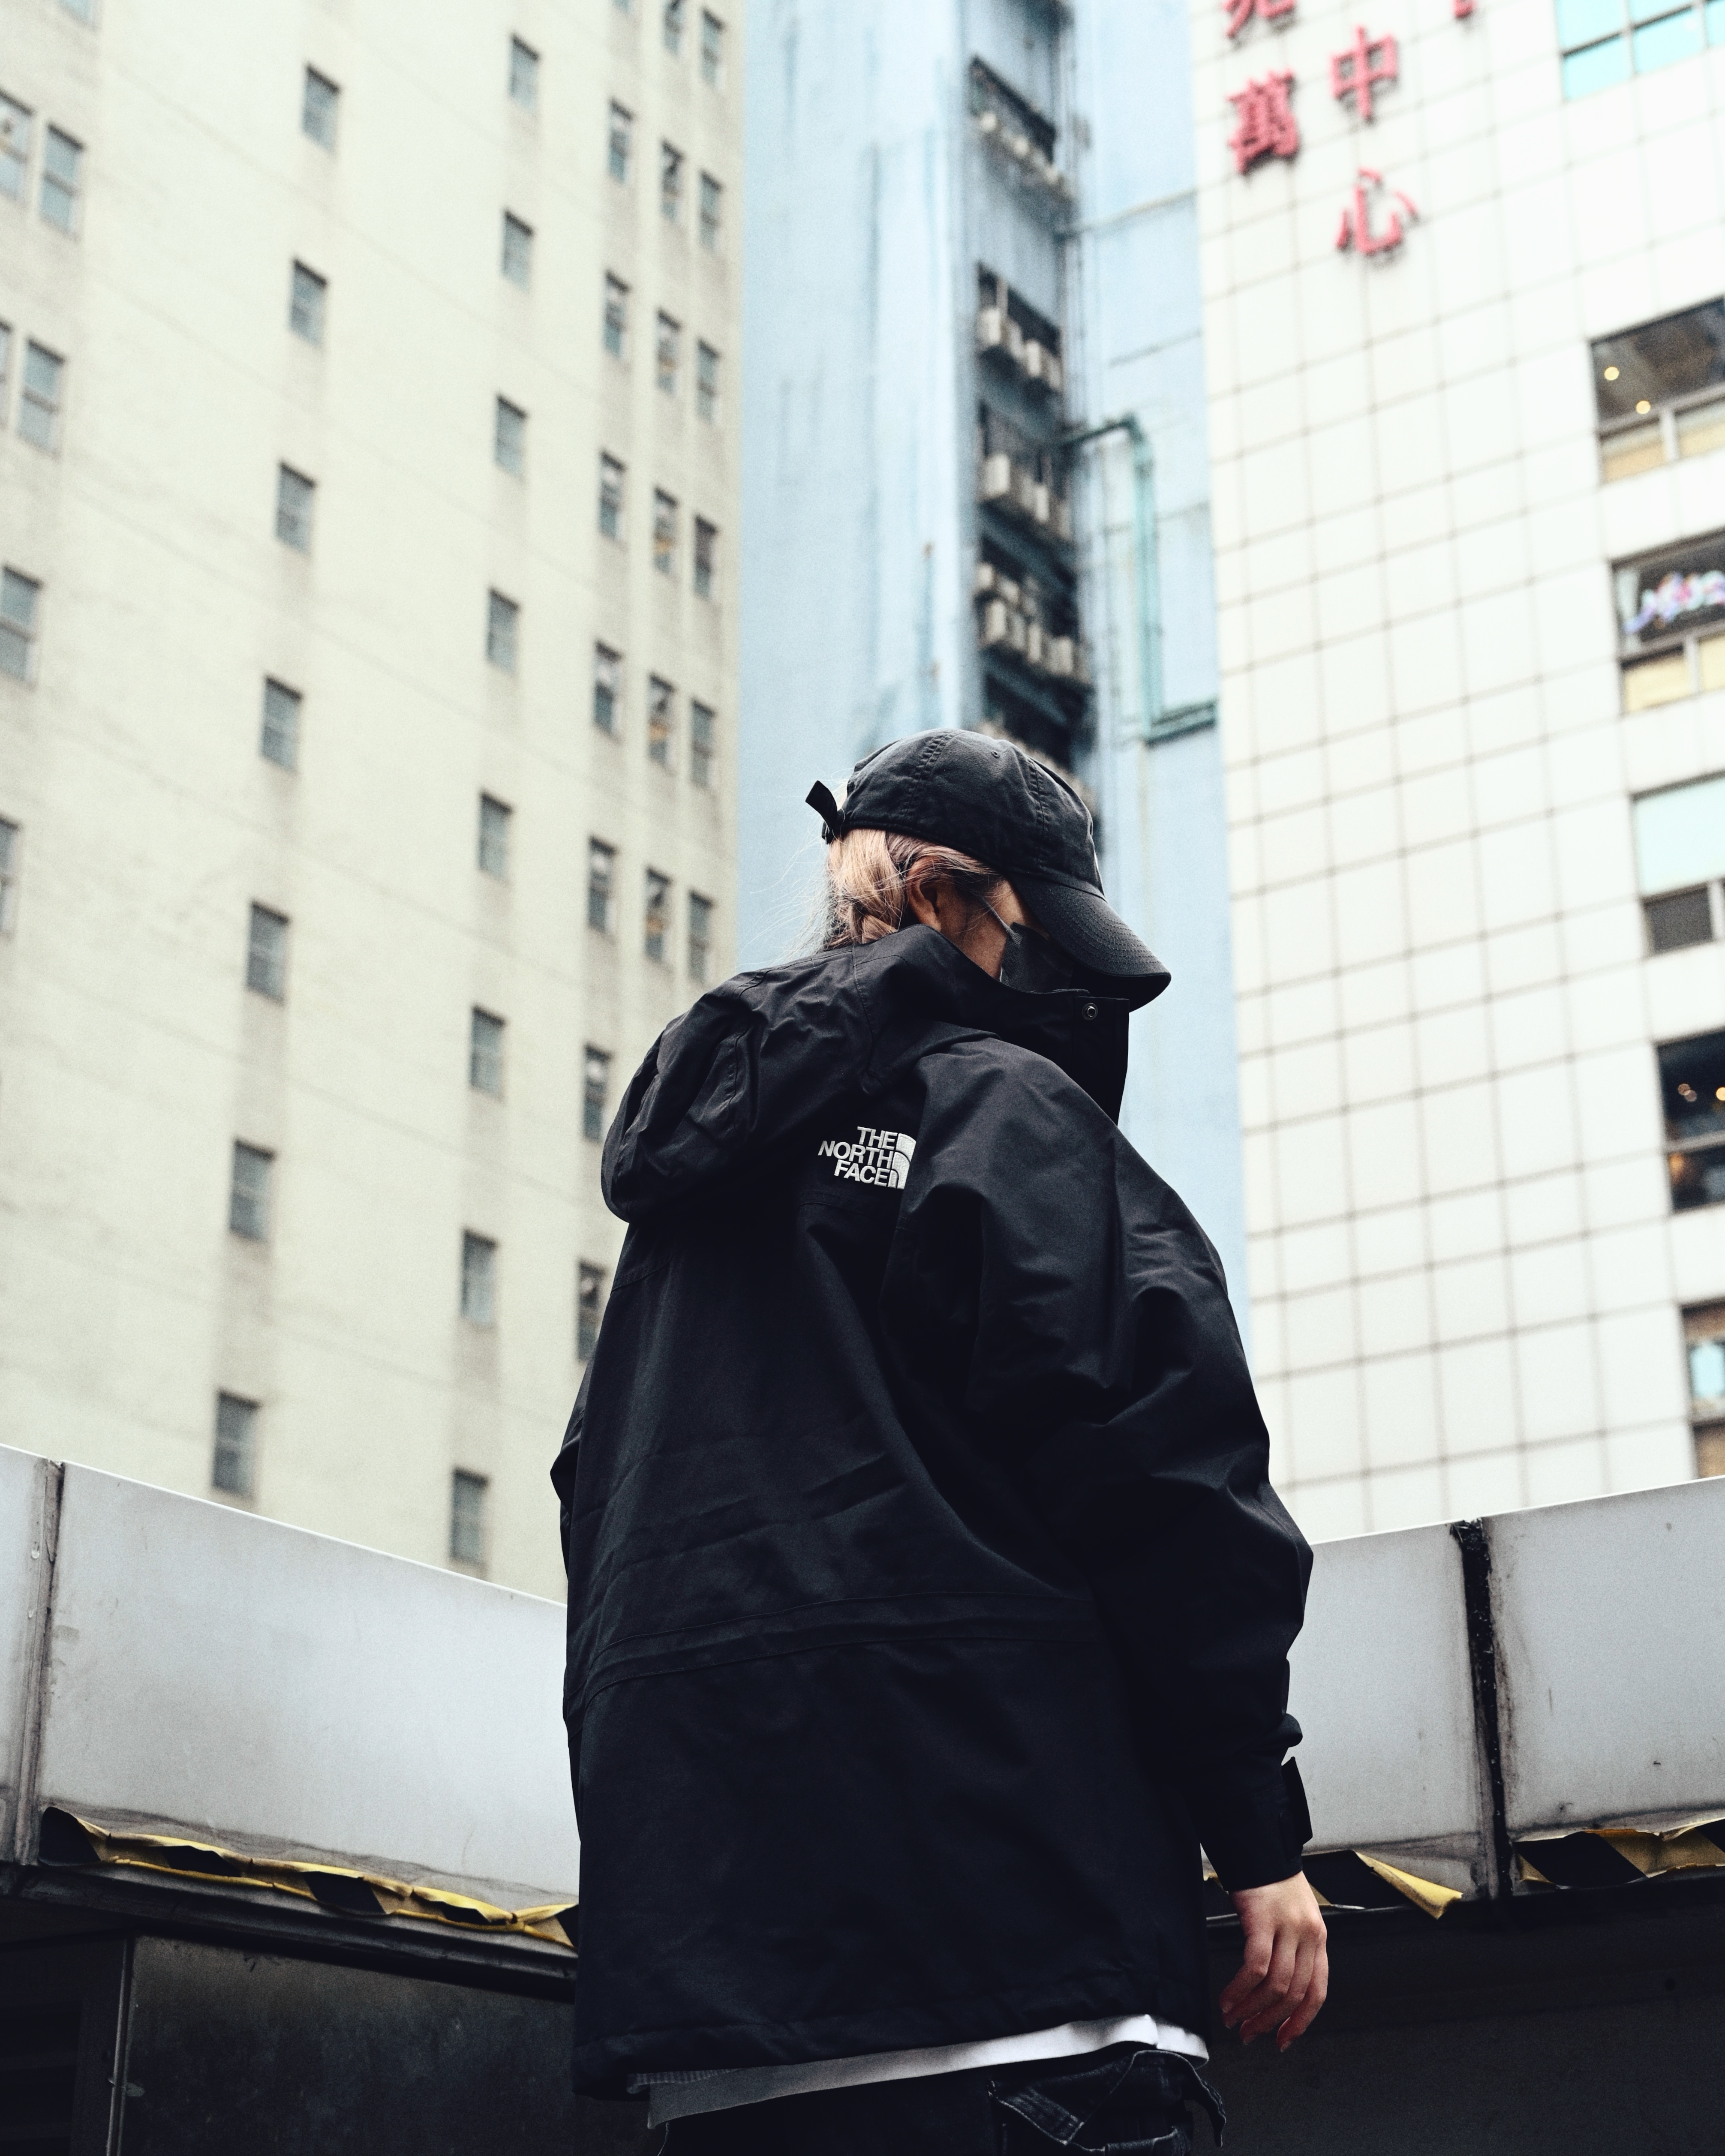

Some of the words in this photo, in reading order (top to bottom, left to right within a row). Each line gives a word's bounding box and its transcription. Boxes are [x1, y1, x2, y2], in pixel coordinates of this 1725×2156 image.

[857, 1126, 898, 1150] THE
[817, 1140, 894, 1169] NORTH
[834, 1159, 891, 1187] FACE
